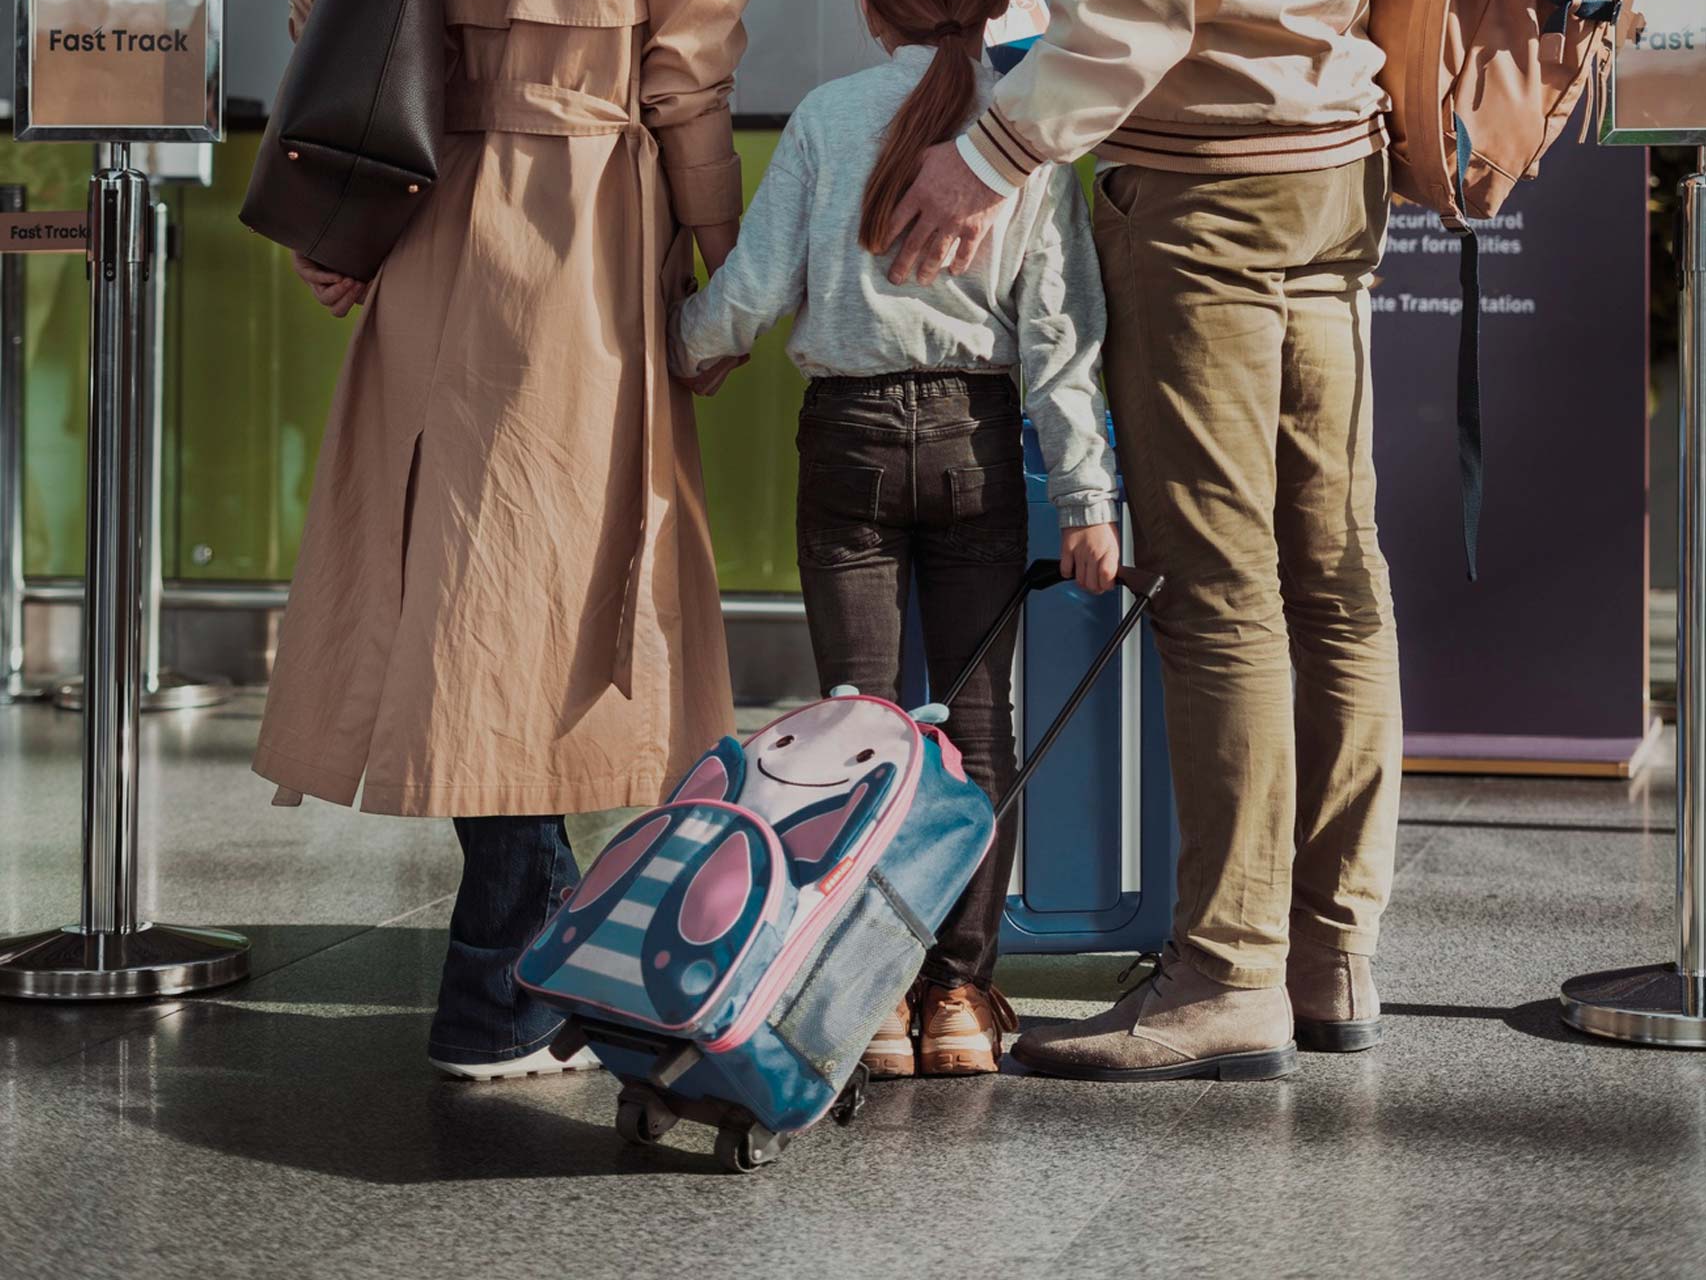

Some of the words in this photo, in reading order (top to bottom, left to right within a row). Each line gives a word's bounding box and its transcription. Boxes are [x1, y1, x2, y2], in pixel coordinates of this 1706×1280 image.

[50, 26, 106, 52] Fast
[112, 29, 188, 52] Track
[10, 224, 42, 240] Fast
[46, 224, 87, 240] Track
[1399, 293, 1535, 315] Transptation
